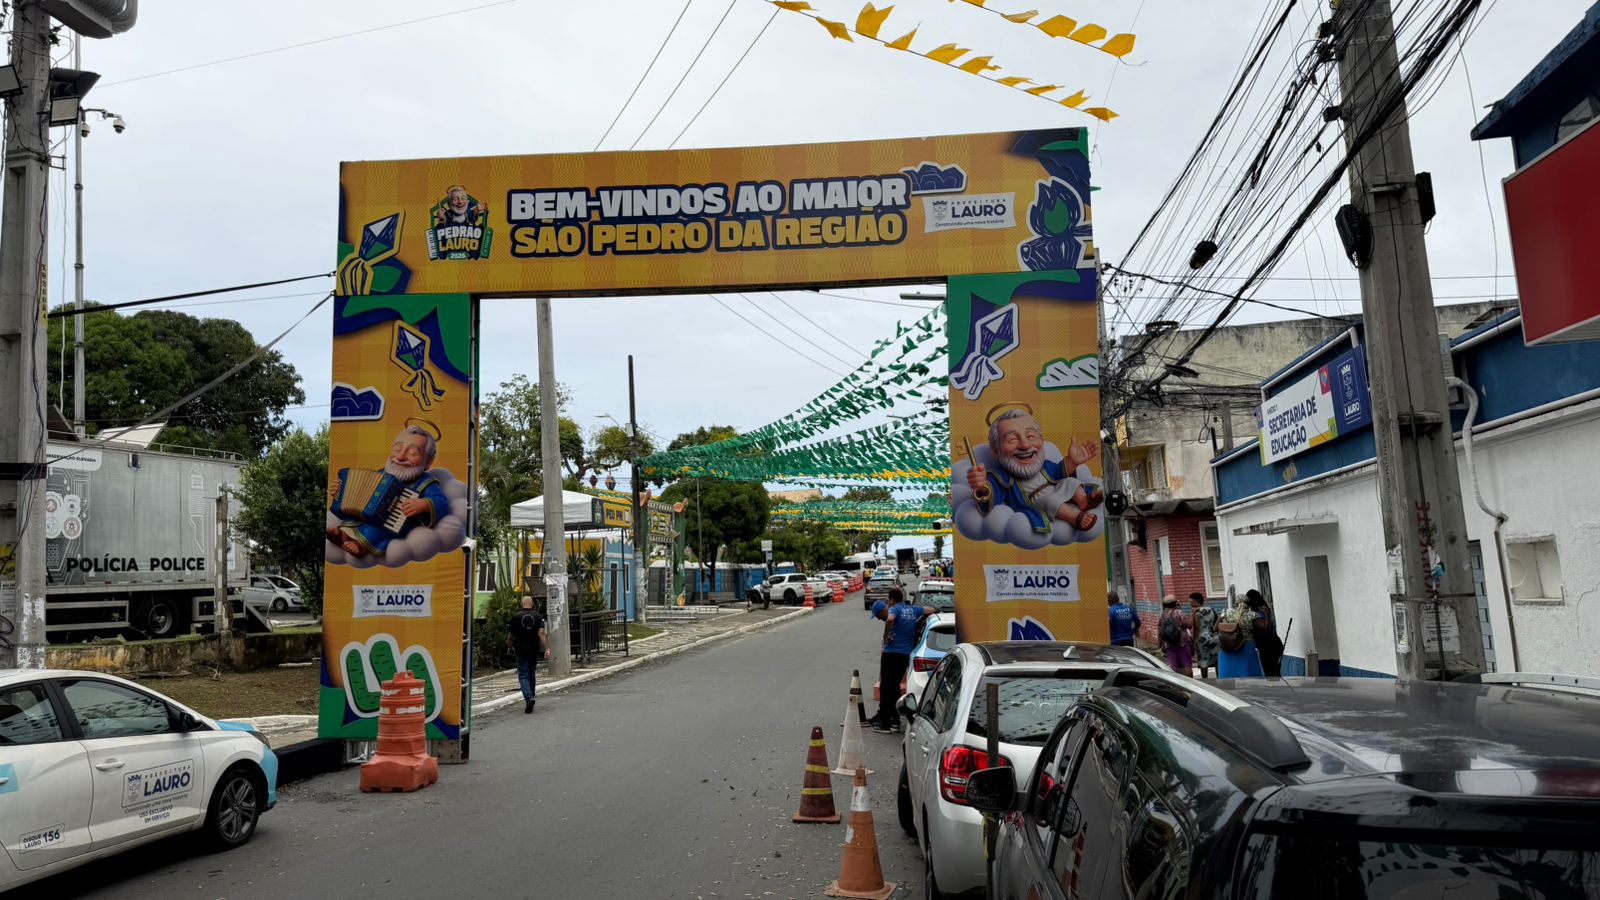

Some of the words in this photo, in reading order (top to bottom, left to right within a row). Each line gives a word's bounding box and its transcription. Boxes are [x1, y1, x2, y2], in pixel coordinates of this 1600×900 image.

[510, 186, 727, 220] BEM-VINDOS
[736, 183, 782, 213] AO
[793, 178, 908, 211] MAIOR
[951, 203, 1007, 218] LAURO
[436, 223, 482, 240] PEDRÃO
[515, 218, 574, 254] SÃO
[593, 222, 708, 252] PEDRO
[720, 218, 766, 249] DA
[777, 207, 903, 246] REGIÃO
[439, 238, 479, 252] LAURO
[1269, 402, 1306, 435] SECRETARIA
[1306, 396, 1318, 417] DE
[1345, 402, 1360, 417] LAURO
[1271, 423, 1306, 455] EDUCAÇÃO
[66, 553, 139, 573] POLÍCIA
[150, 556, 205, 571] POLICE
[1013, 575, 1070, 588] LAURO
[377, 595, 424, 606] LAURO
[145, 765, 191, 779] PREFEITURA
[144, 771, 190, 796] LAURO
[151, 812, 170, 823] SERVIÇO
[23, 834, 41, 843] DISQUE
[43, 829, 60, 843] 156
[24, 840, 42, 849] LAURO
